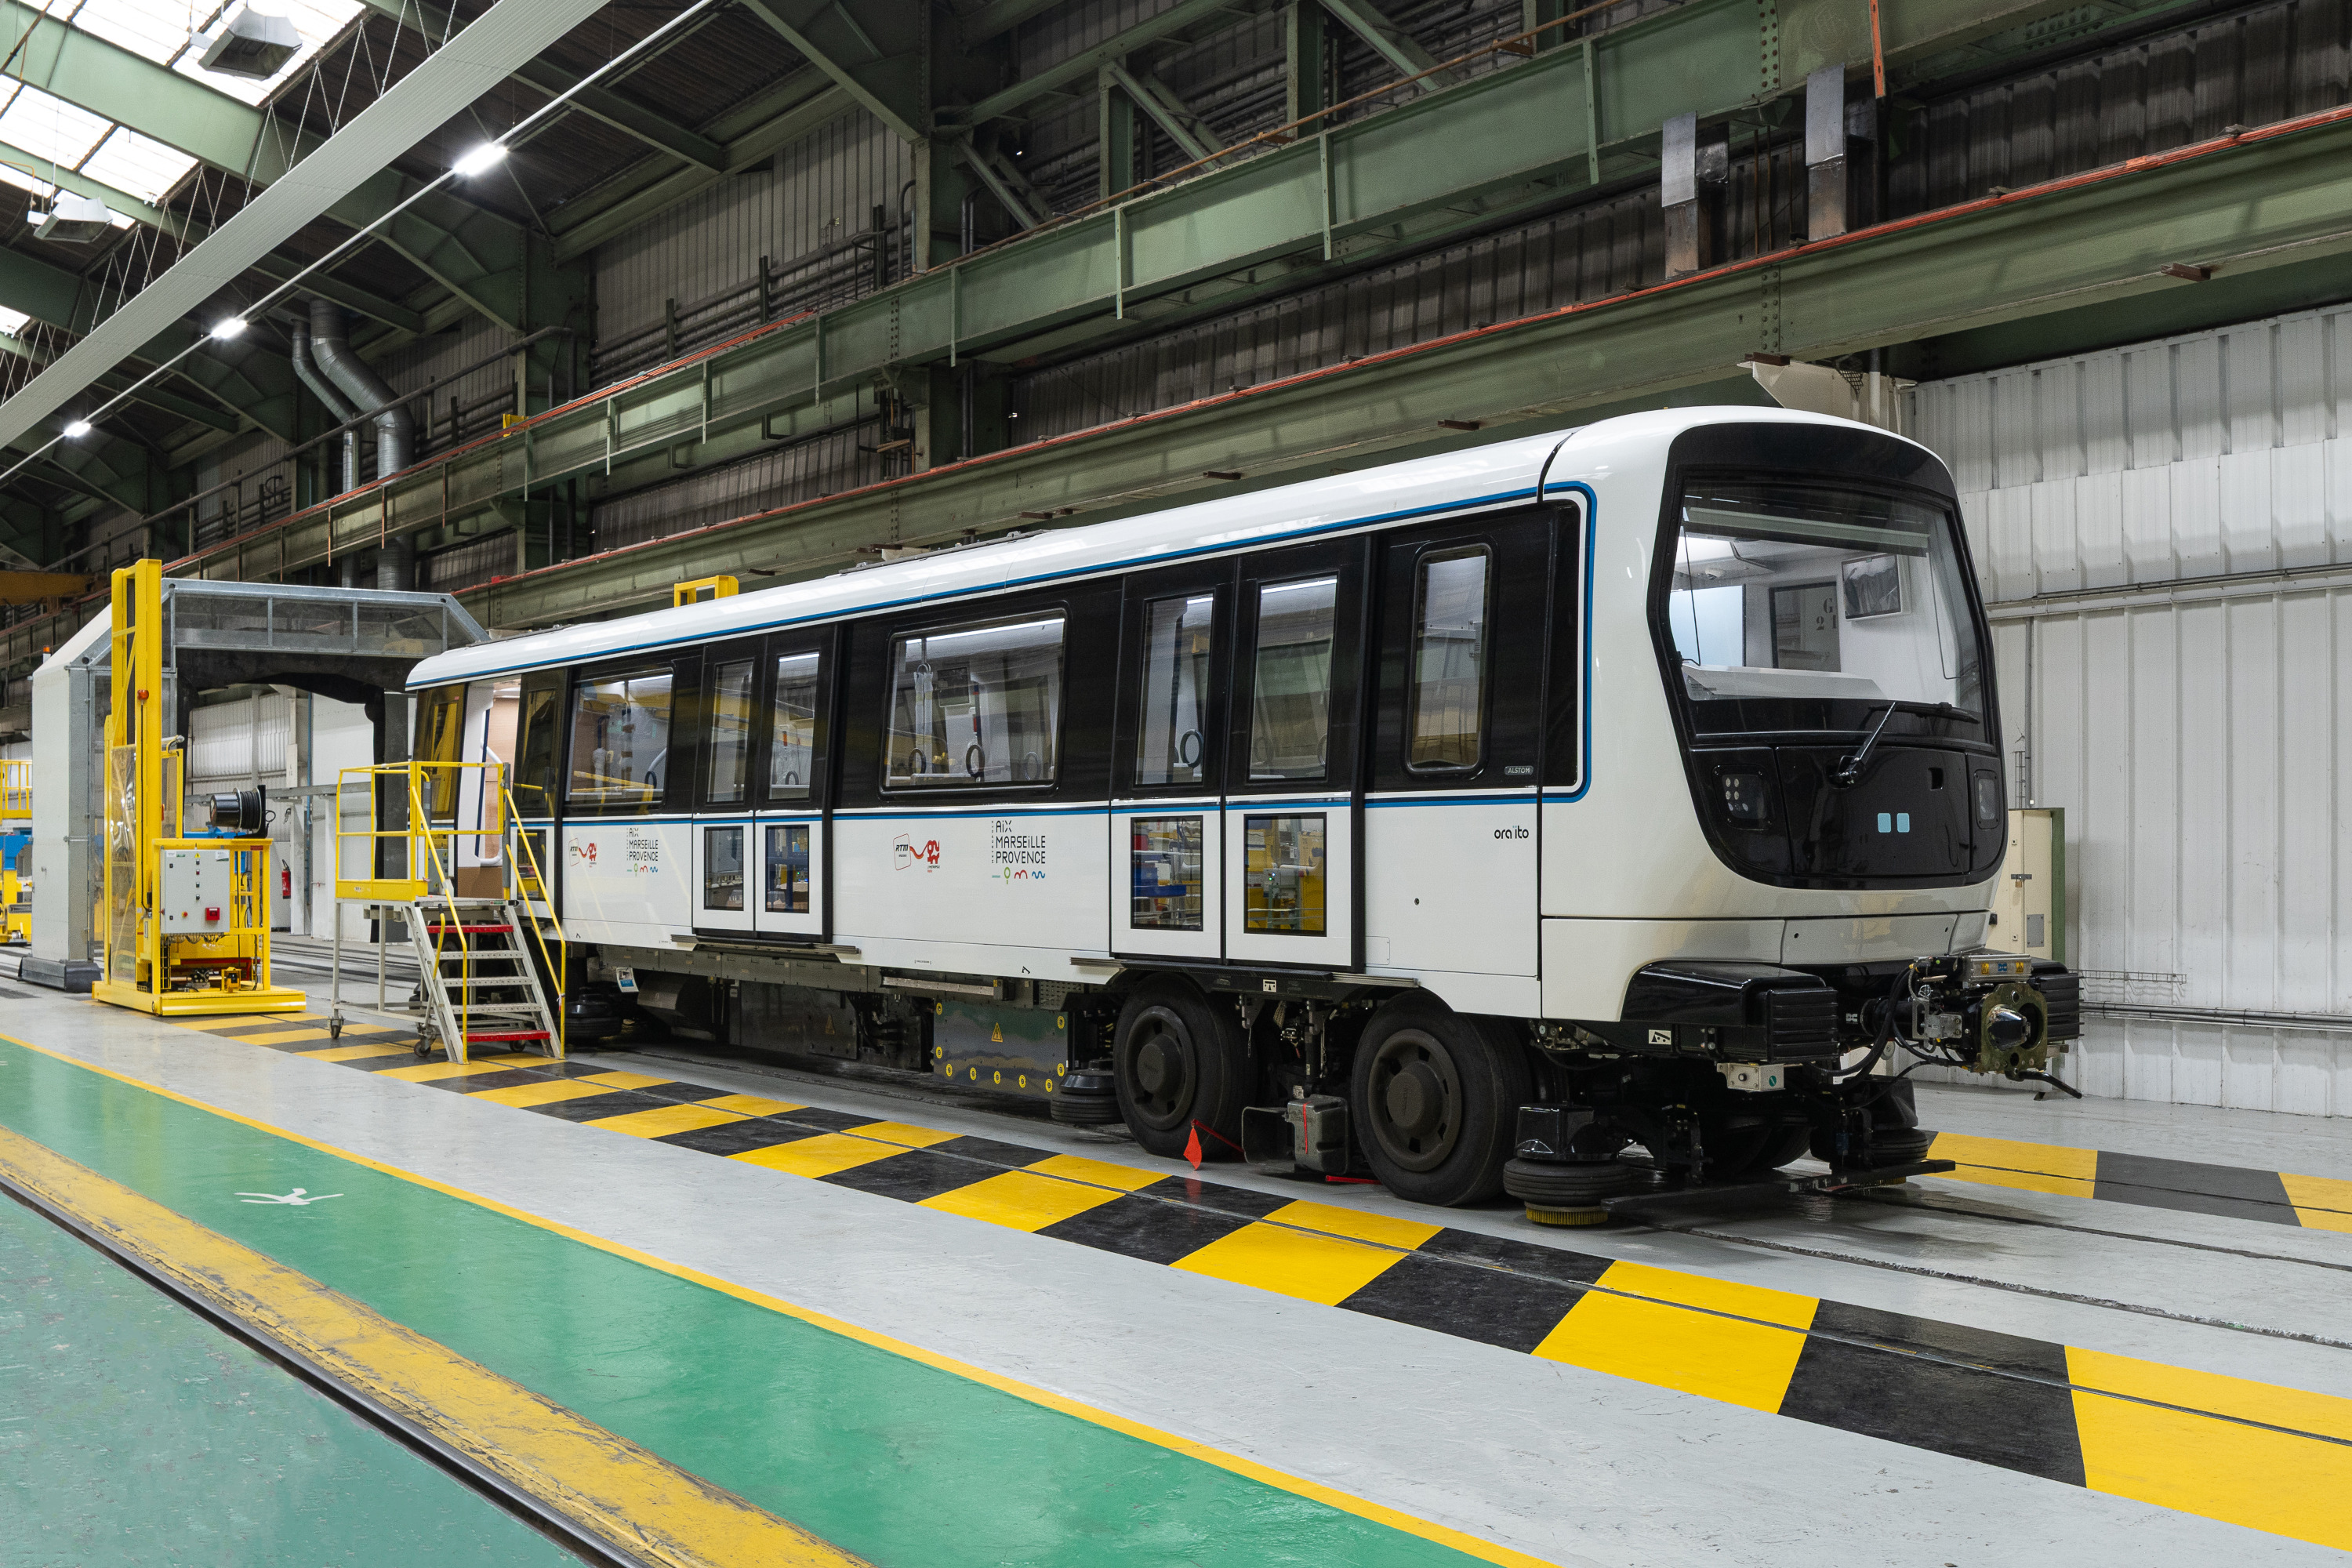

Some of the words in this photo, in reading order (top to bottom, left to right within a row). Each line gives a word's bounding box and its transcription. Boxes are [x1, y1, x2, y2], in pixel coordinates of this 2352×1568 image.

[1824, 597, 1833, 613] G
[895, 844, 909, 852] RTM
[629, 851, 659, 862] PROVENCE
[996, 851, 1046, 864] PROVENCE
